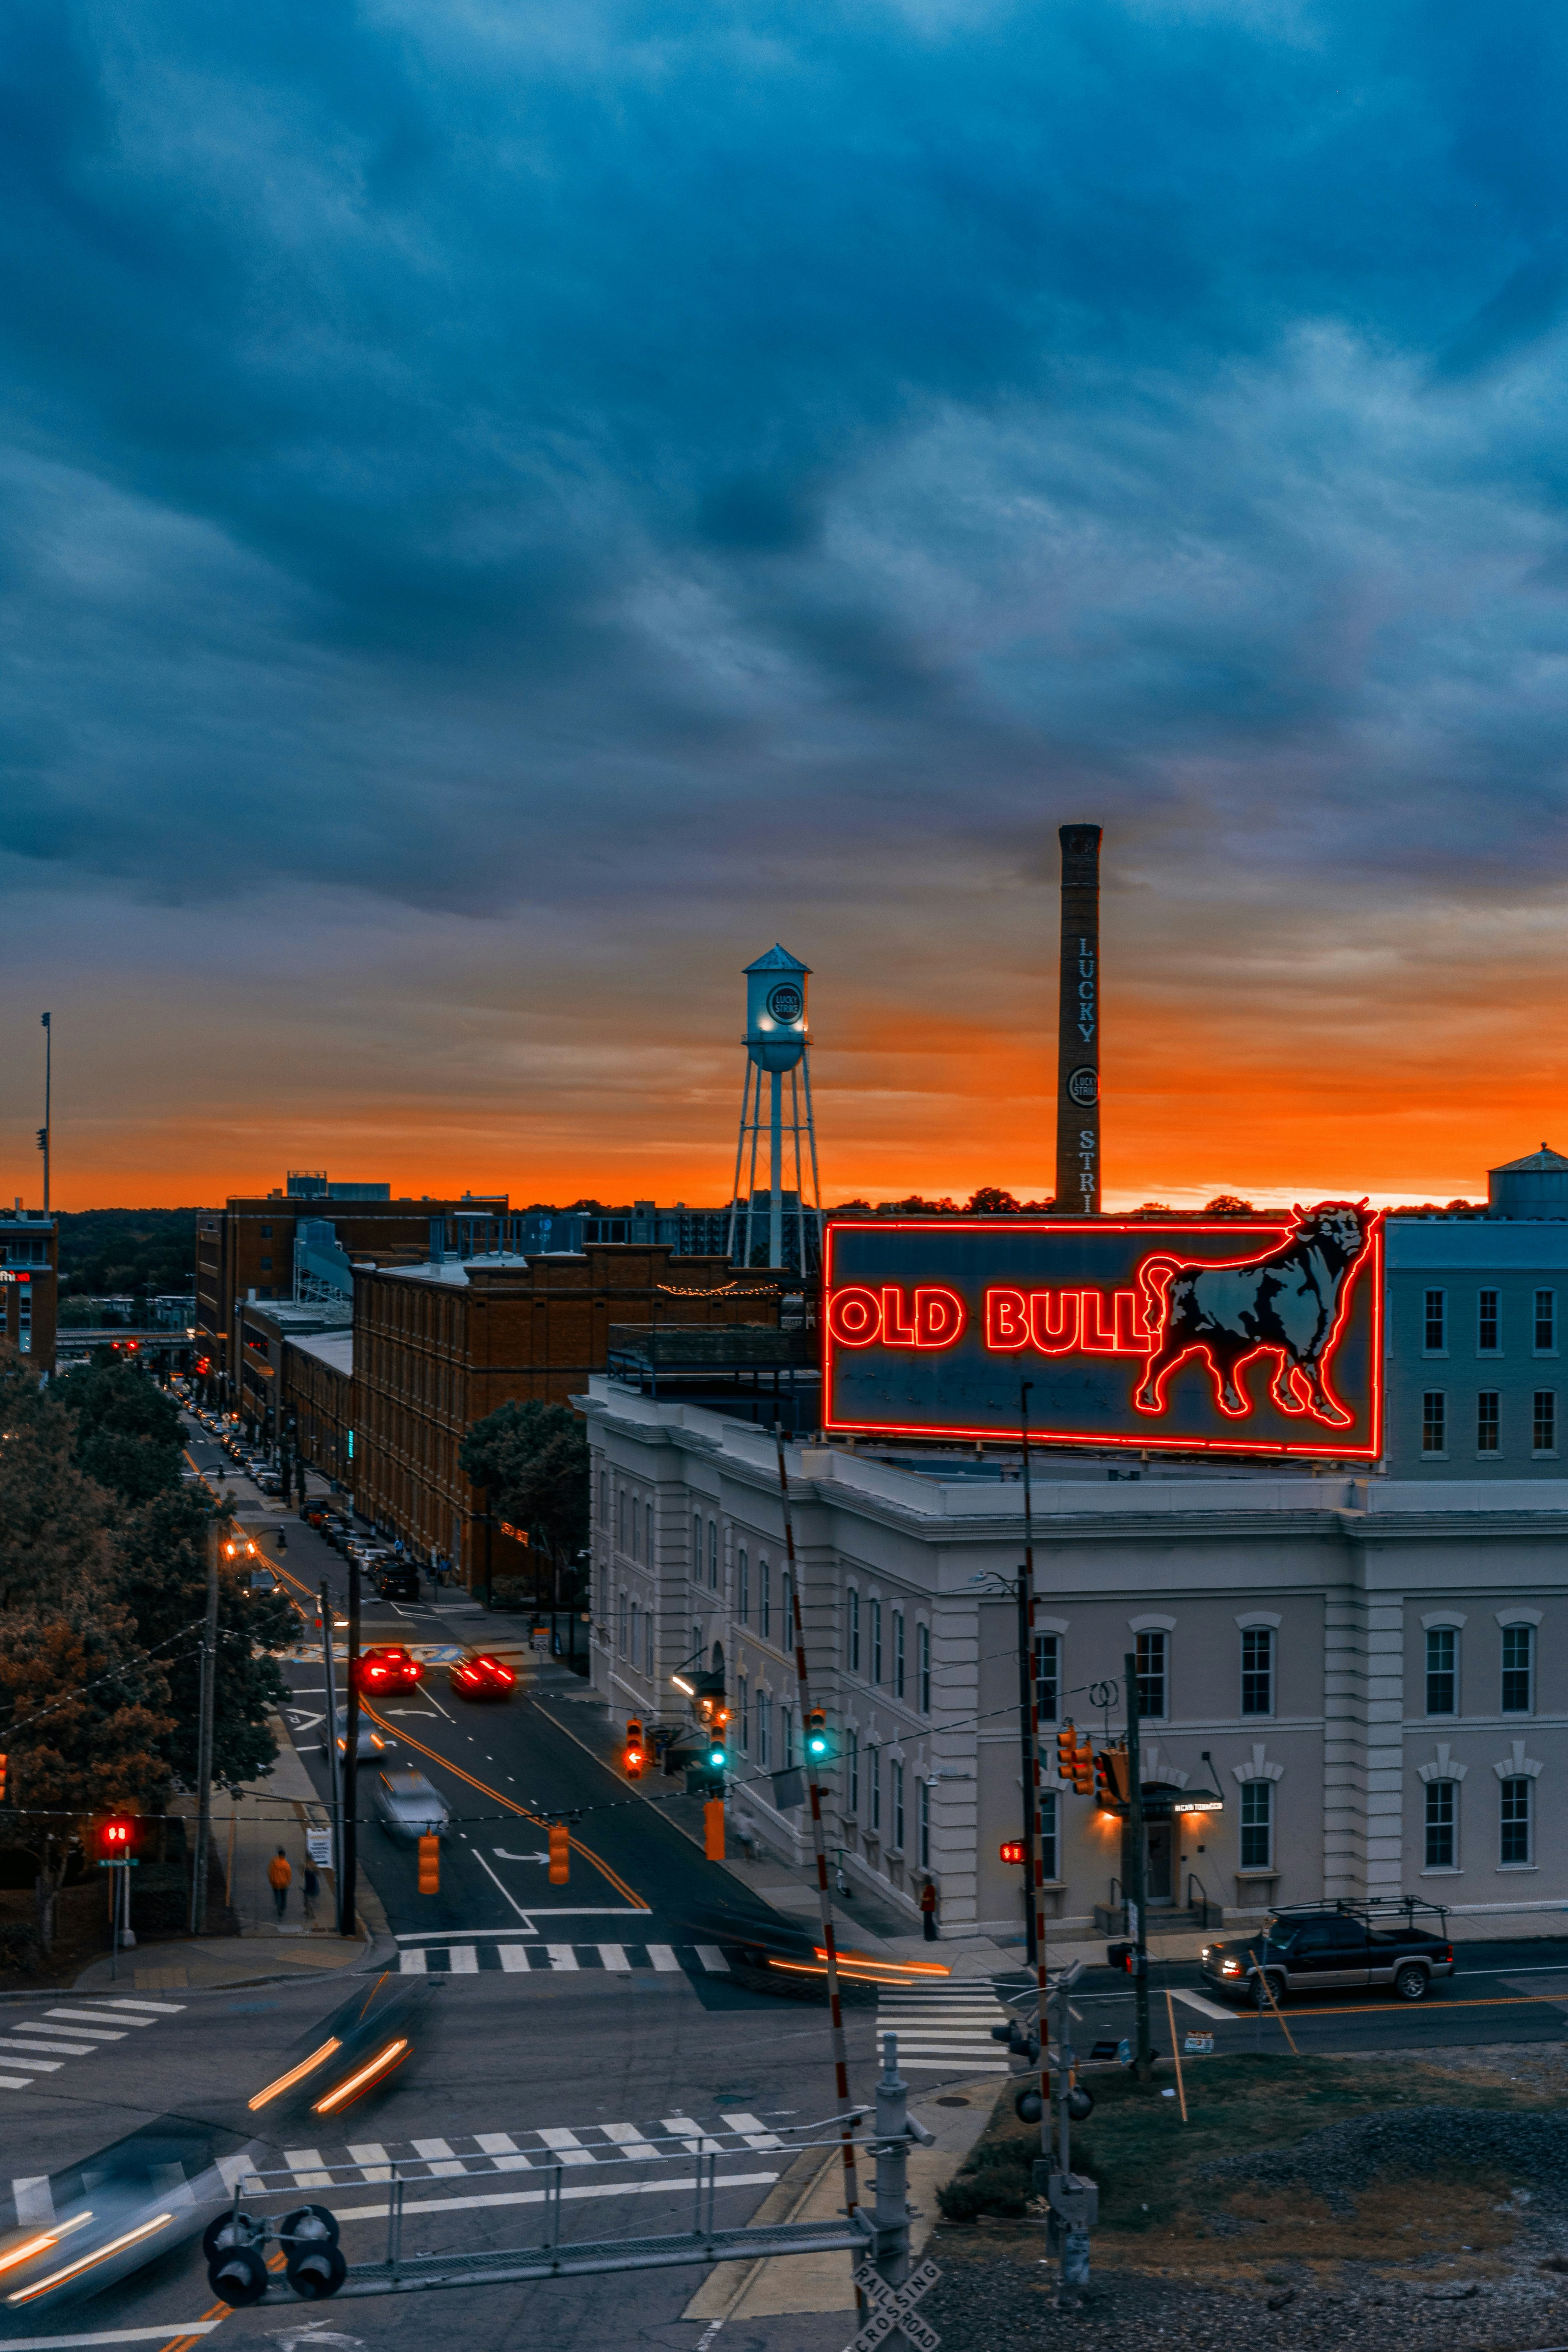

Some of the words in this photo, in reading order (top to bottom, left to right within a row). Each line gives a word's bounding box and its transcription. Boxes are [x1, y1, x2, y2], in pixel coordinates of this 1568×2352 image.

[775, 1005, 798, 1013] STRIKE
[776, 995, 798, 1004] LUCKY
[1077, 938, 1096, 1042] LUCKY
[827, 1287, 963, 1347] OLD
[987, 1290, 1152, 1353] BULL
[854, 2266, 889, 2306] RAIL
[902, 2312, 936, 2348] ROAD
[855, 2265, 937, 2352] CROSSING
